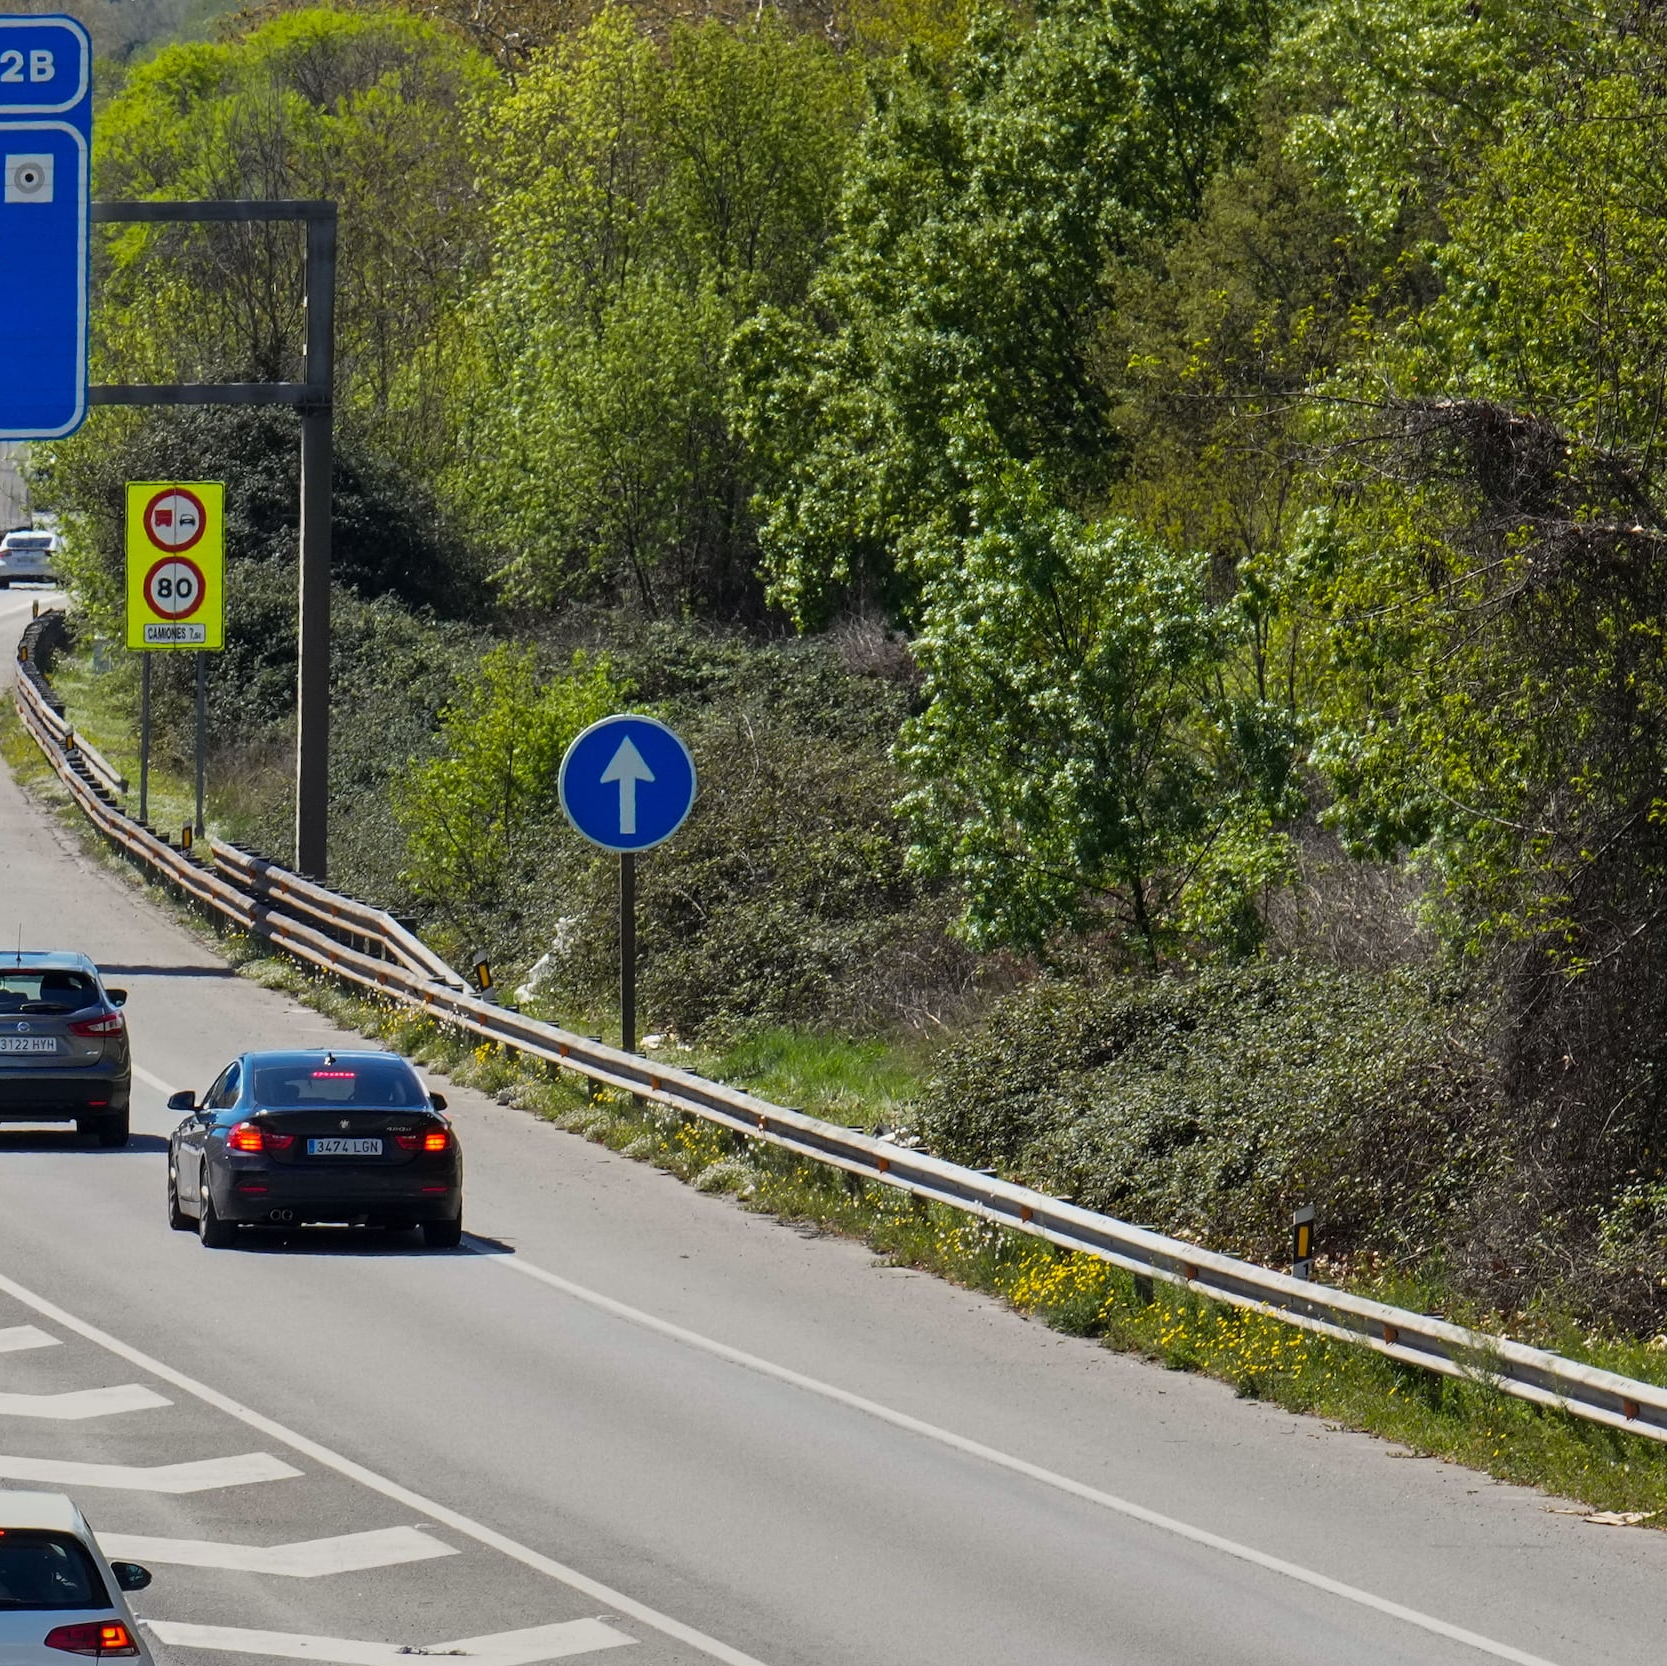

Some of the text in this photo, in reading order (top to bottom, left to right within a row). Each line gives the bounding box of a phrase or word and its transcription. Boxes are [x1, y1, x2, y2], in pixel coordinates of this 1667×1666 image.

[157, 578, 192, 599] 80
[148, 627, 186, 640] CAMIONES
[0, 1040, 55, 1050] 3122 HYH
[317, 1141, 379, 1152] 3474 LGN
